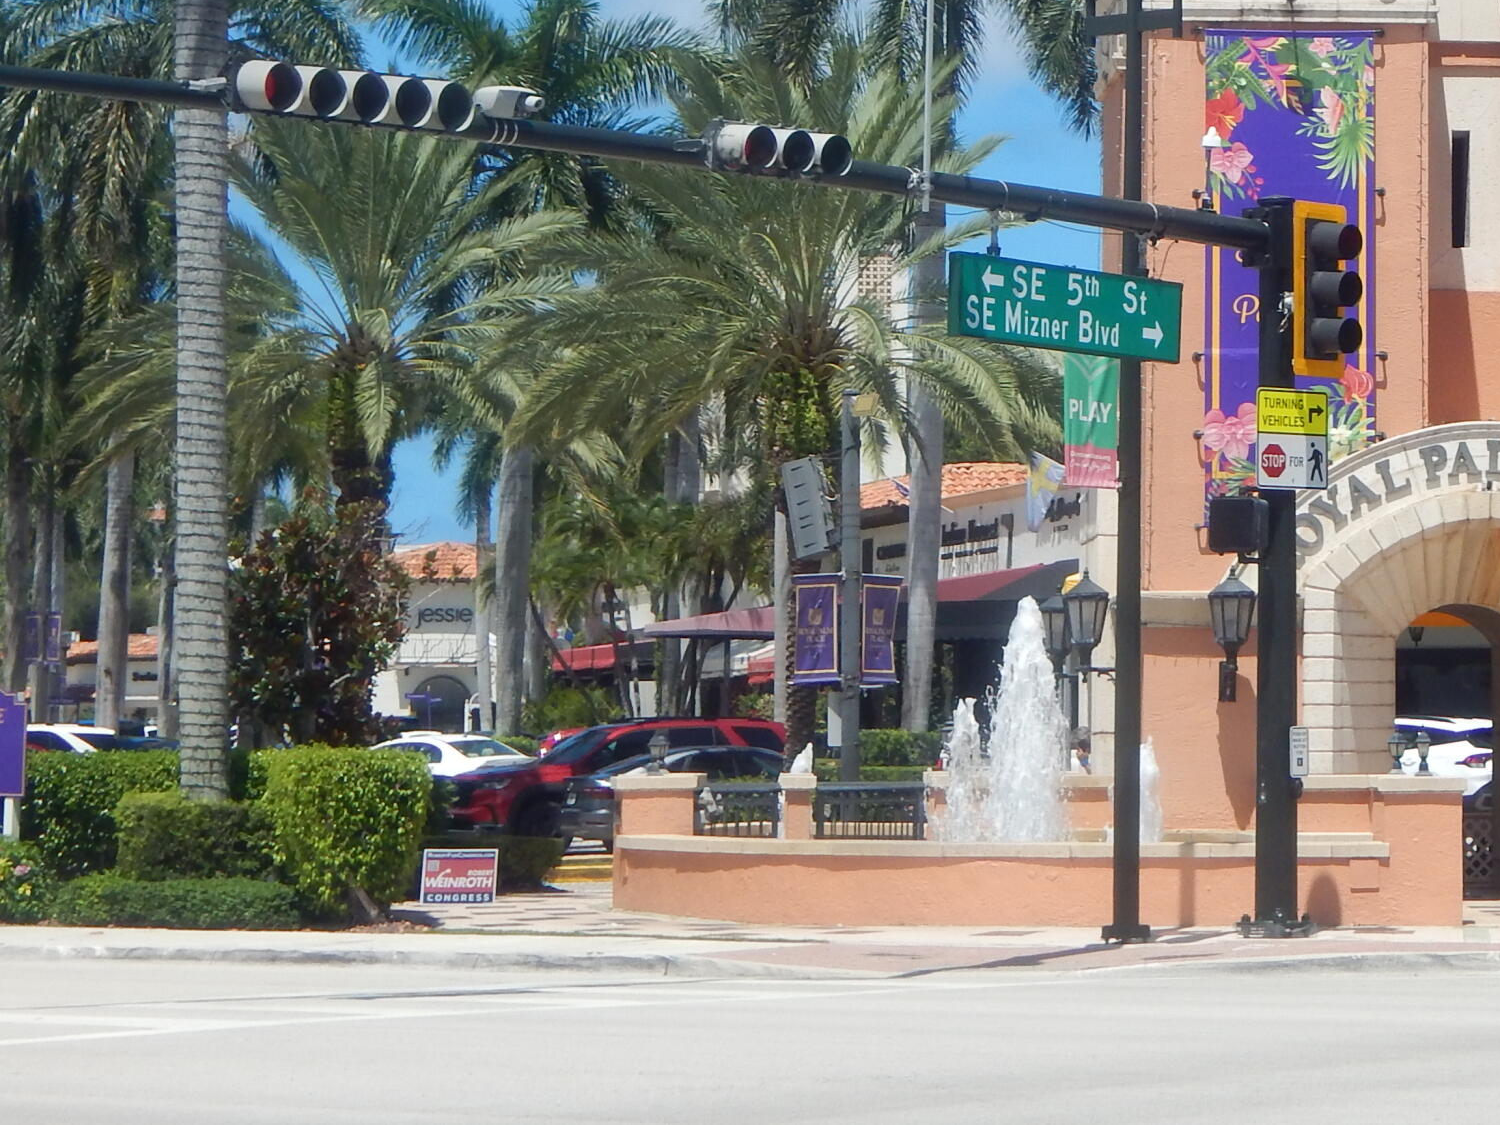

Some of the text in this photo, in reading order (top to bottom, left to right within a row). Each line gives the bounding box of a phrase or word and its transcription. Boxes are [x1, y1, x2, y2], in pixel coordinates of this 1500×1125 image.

[1012, 265, 1147, 316] SE 5th St
[966, 294, 1120, 348] SE Mizner Blvd
[1069, 398, 1112, 424] PLAY
[1264, 396, 1304, 410] TURNING
[1262, 414, 1305, 428] VEHICLES
[1262, 454, 1304, 468] STOP FOR
[1296, 458, 1412, 569] OYAL
[415, 606, 474, 629] jessie
[425, 871, 493, 888] WEINROTH
[426, 893, 490, 902] CONGRESS
